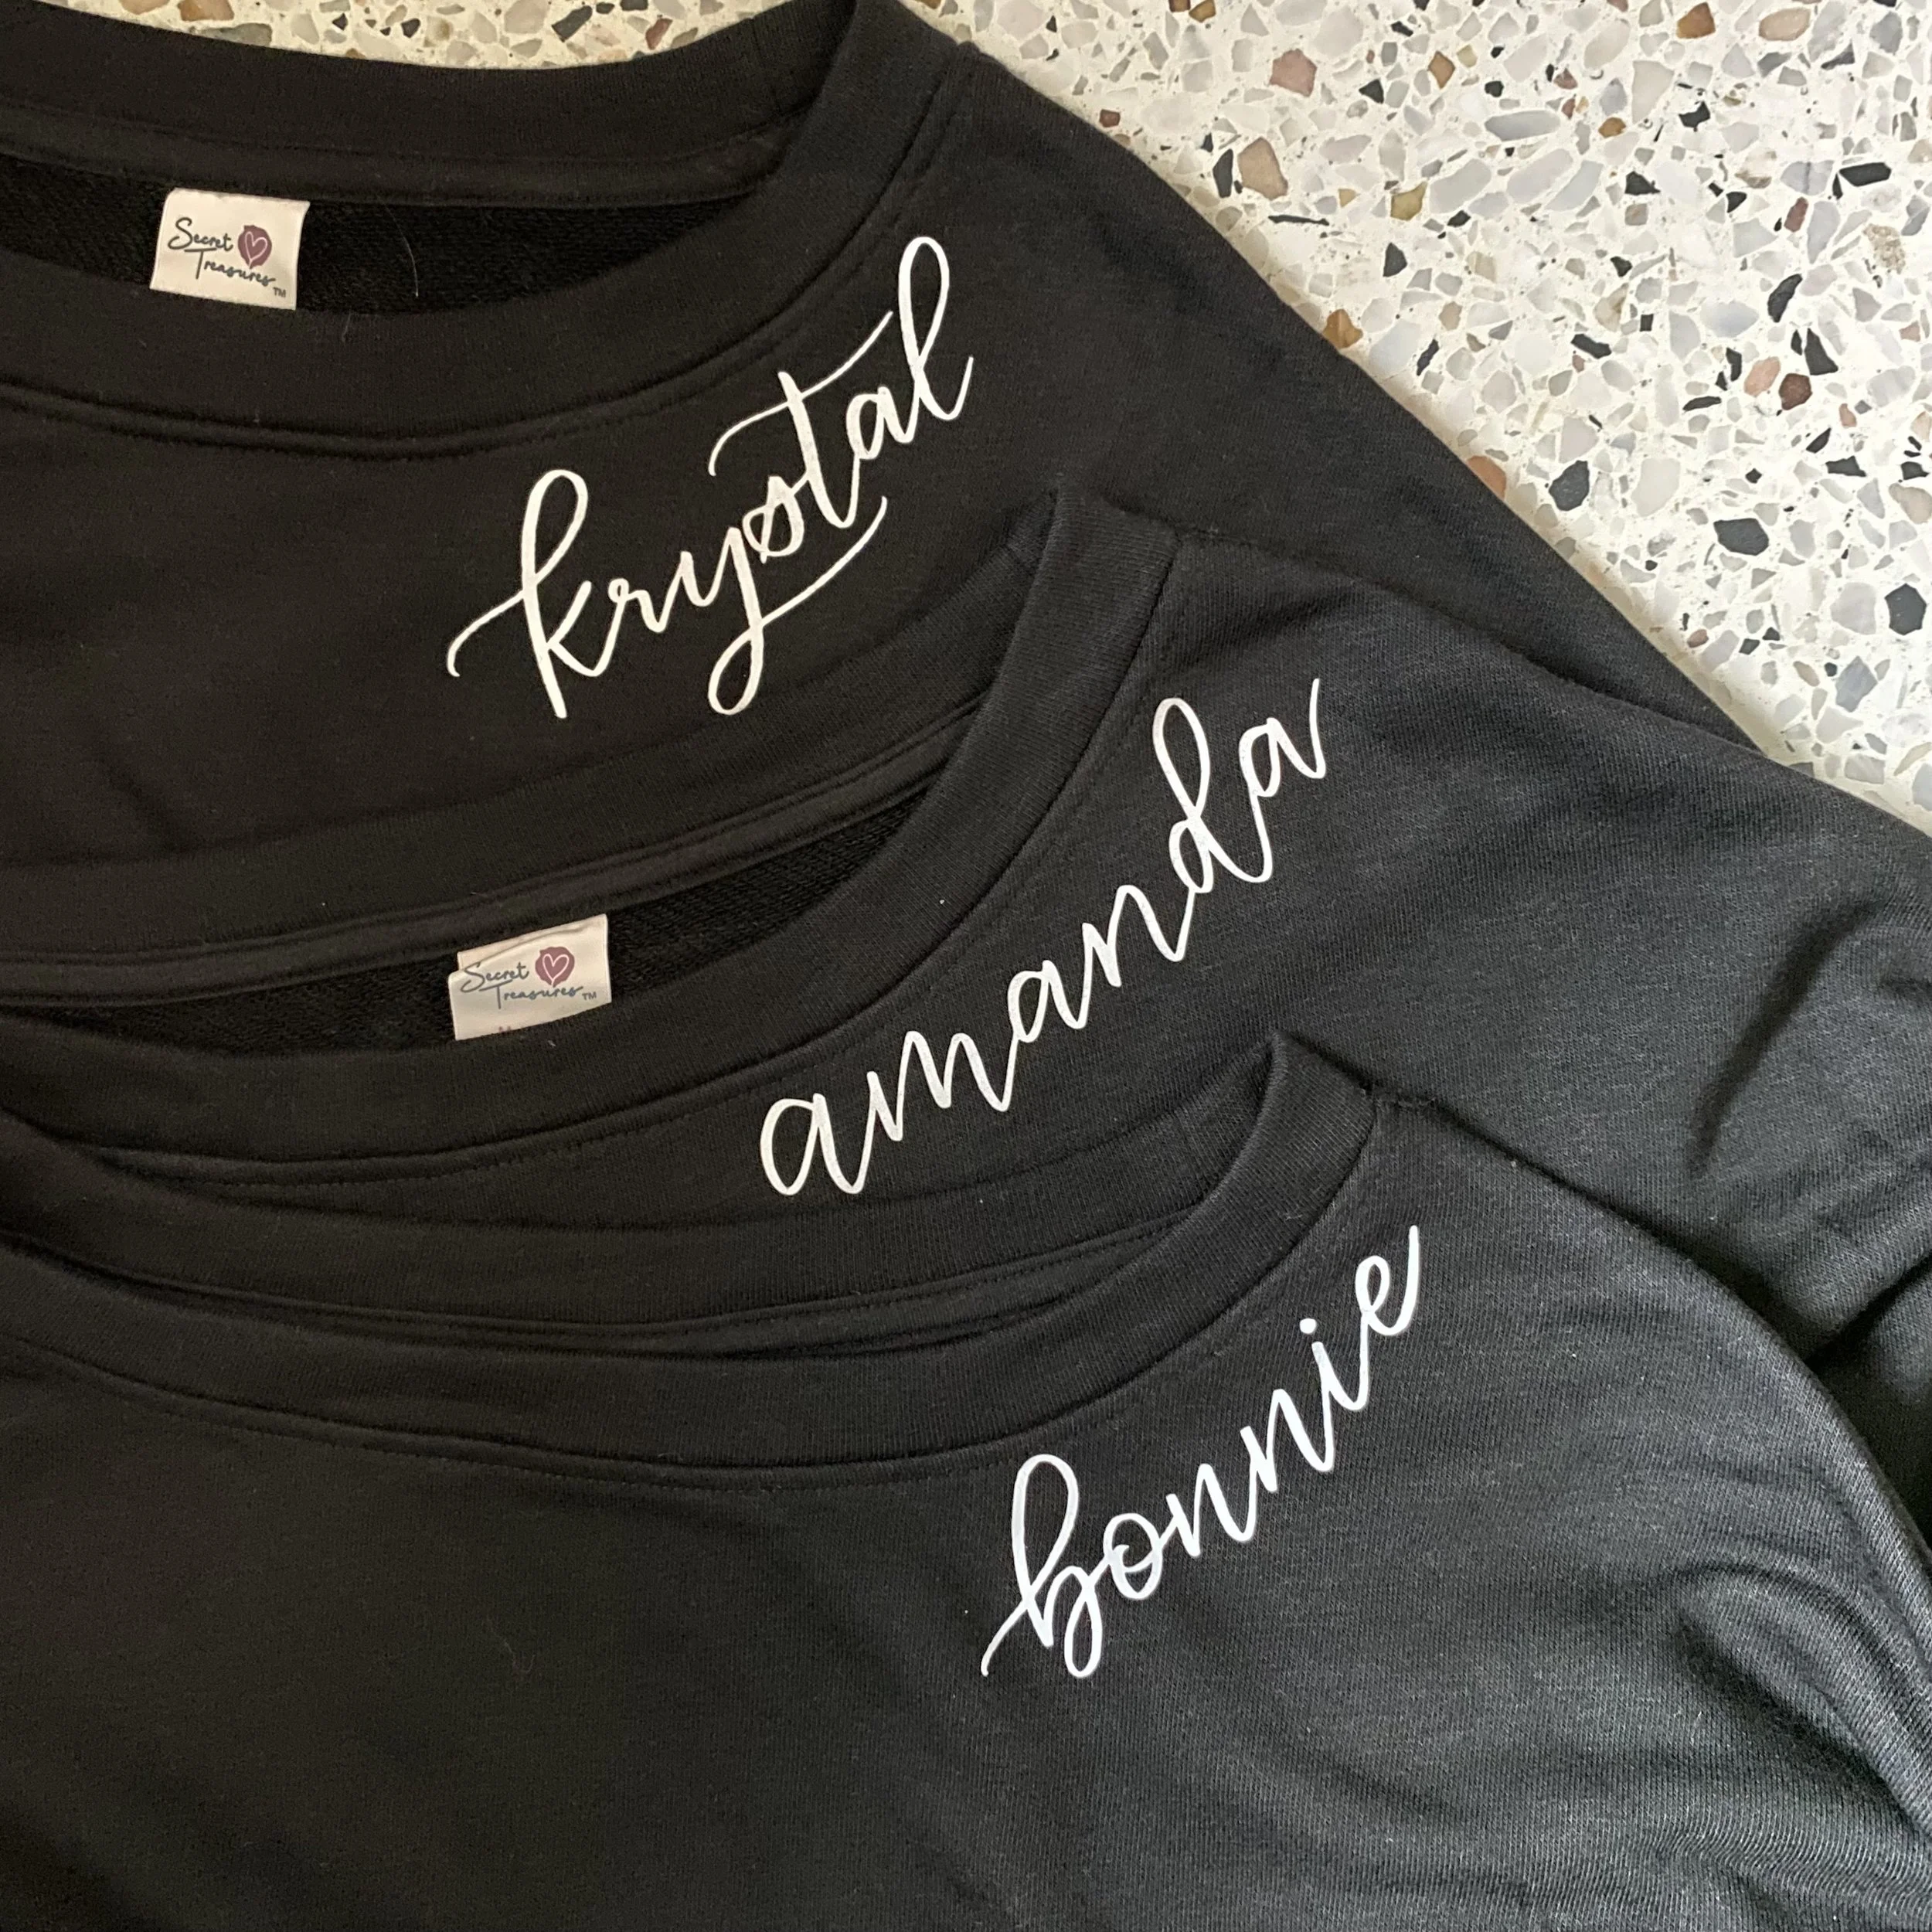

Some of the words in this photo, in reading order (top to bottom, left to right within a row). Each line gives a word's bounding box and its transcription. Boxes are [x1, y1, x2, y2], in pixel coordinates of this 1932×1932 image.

[168, 216, 233, 251] Secret
[184, 247, 276, 286] Treasures
[447, 236, 975, 719] krystal
[760, 677, 1327, 1196] amanda
[460, 962, 529, 992] Secret
[478, 979, 583, 1009] Treasures
[980, 1225, 1420, 1679] bonnie
